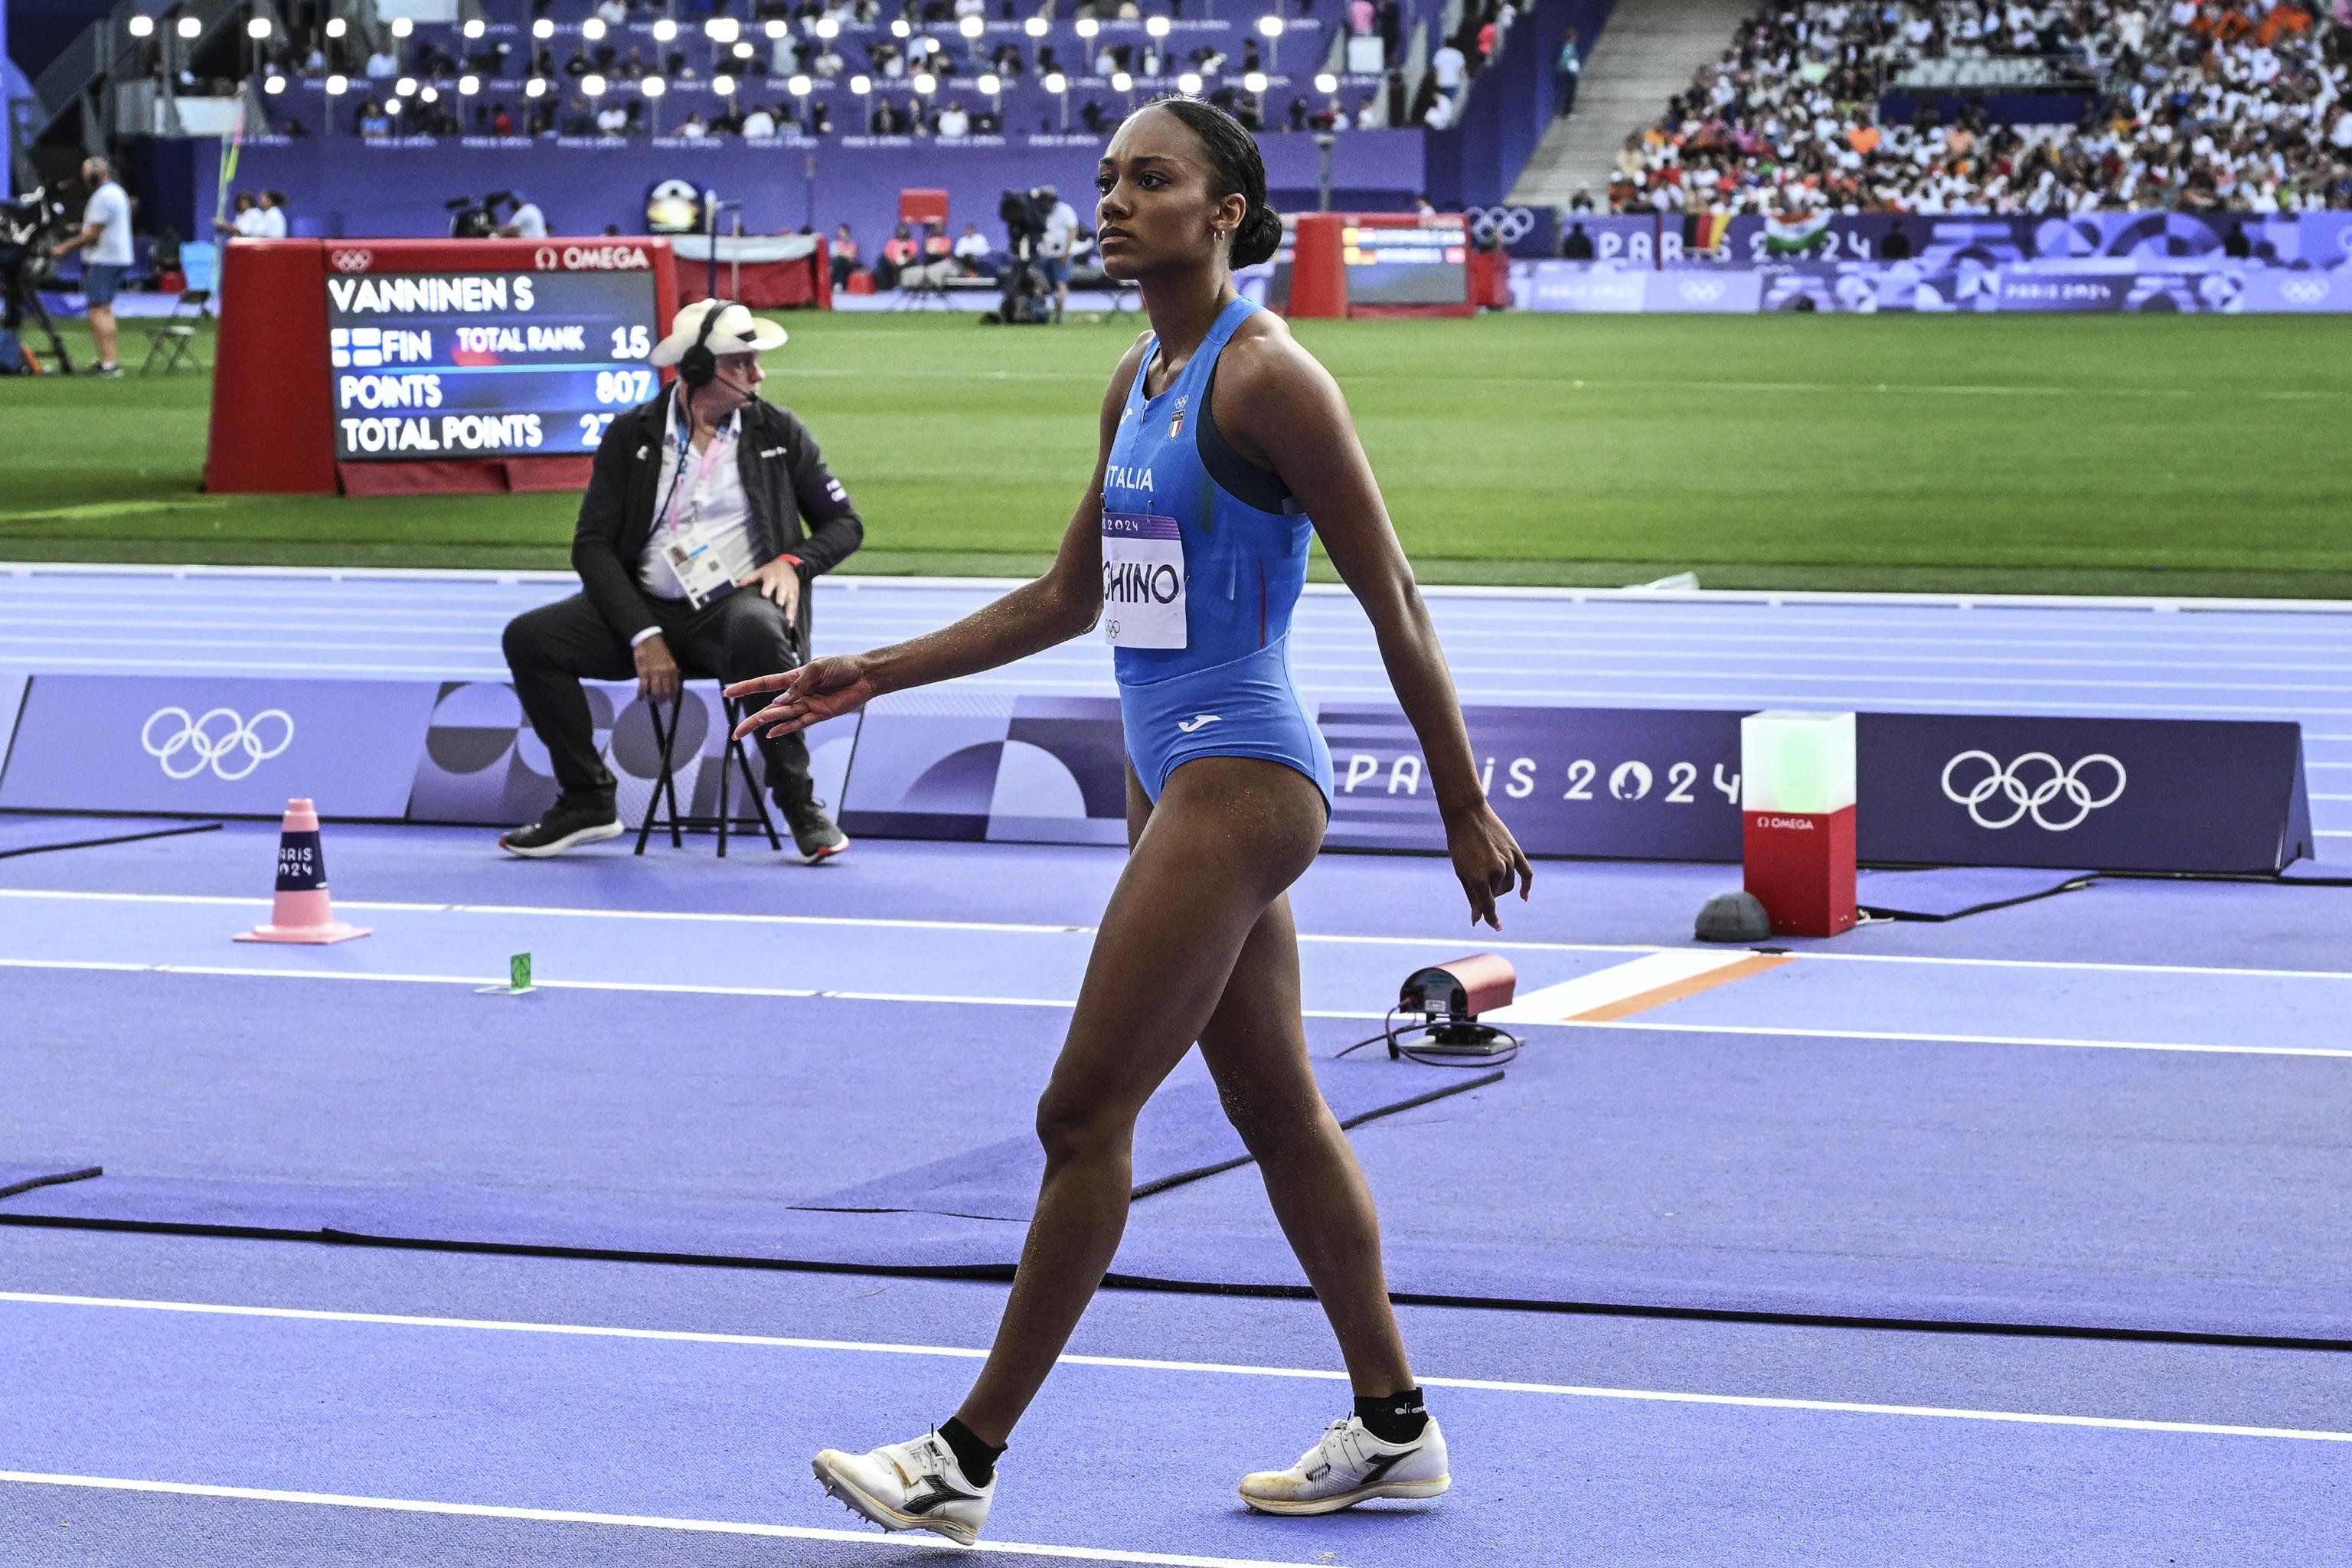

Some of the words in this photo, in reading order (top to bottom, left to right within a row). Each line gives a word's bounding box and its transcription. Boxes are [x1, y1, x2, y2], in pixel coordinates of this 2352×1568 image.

[563, 247, 649, 269] OMEGA
[1598, 231, 1732, 263] PARS
[1749, 230, 1870, 263] 224
[328, 277, 507, 312] VANNINEN
[514, 276, 534, 311] S
[383, 330, 432, 361] FIN
[456, 327, 527, 352] TOTAL
[528, 326, 586, 351] RANK
[611, 326, 650, 358] 15
[340, 374, 443, 408] POINTS
[596, 371, 652, 403] 807
[341, 417, 439, 451] TOTAL
[443, 415, 543, 449] POINTS
[1105, 465, 1154, 492] ITALIA
[1107, 519, 1138, 531] 2024
[1102, 560, 1179, 604] CHINO
[1563, 759, 1741, 804] 2024
[1771, 817, 1814, 830] OMEGA
[279, 862, 313, 877] 024
